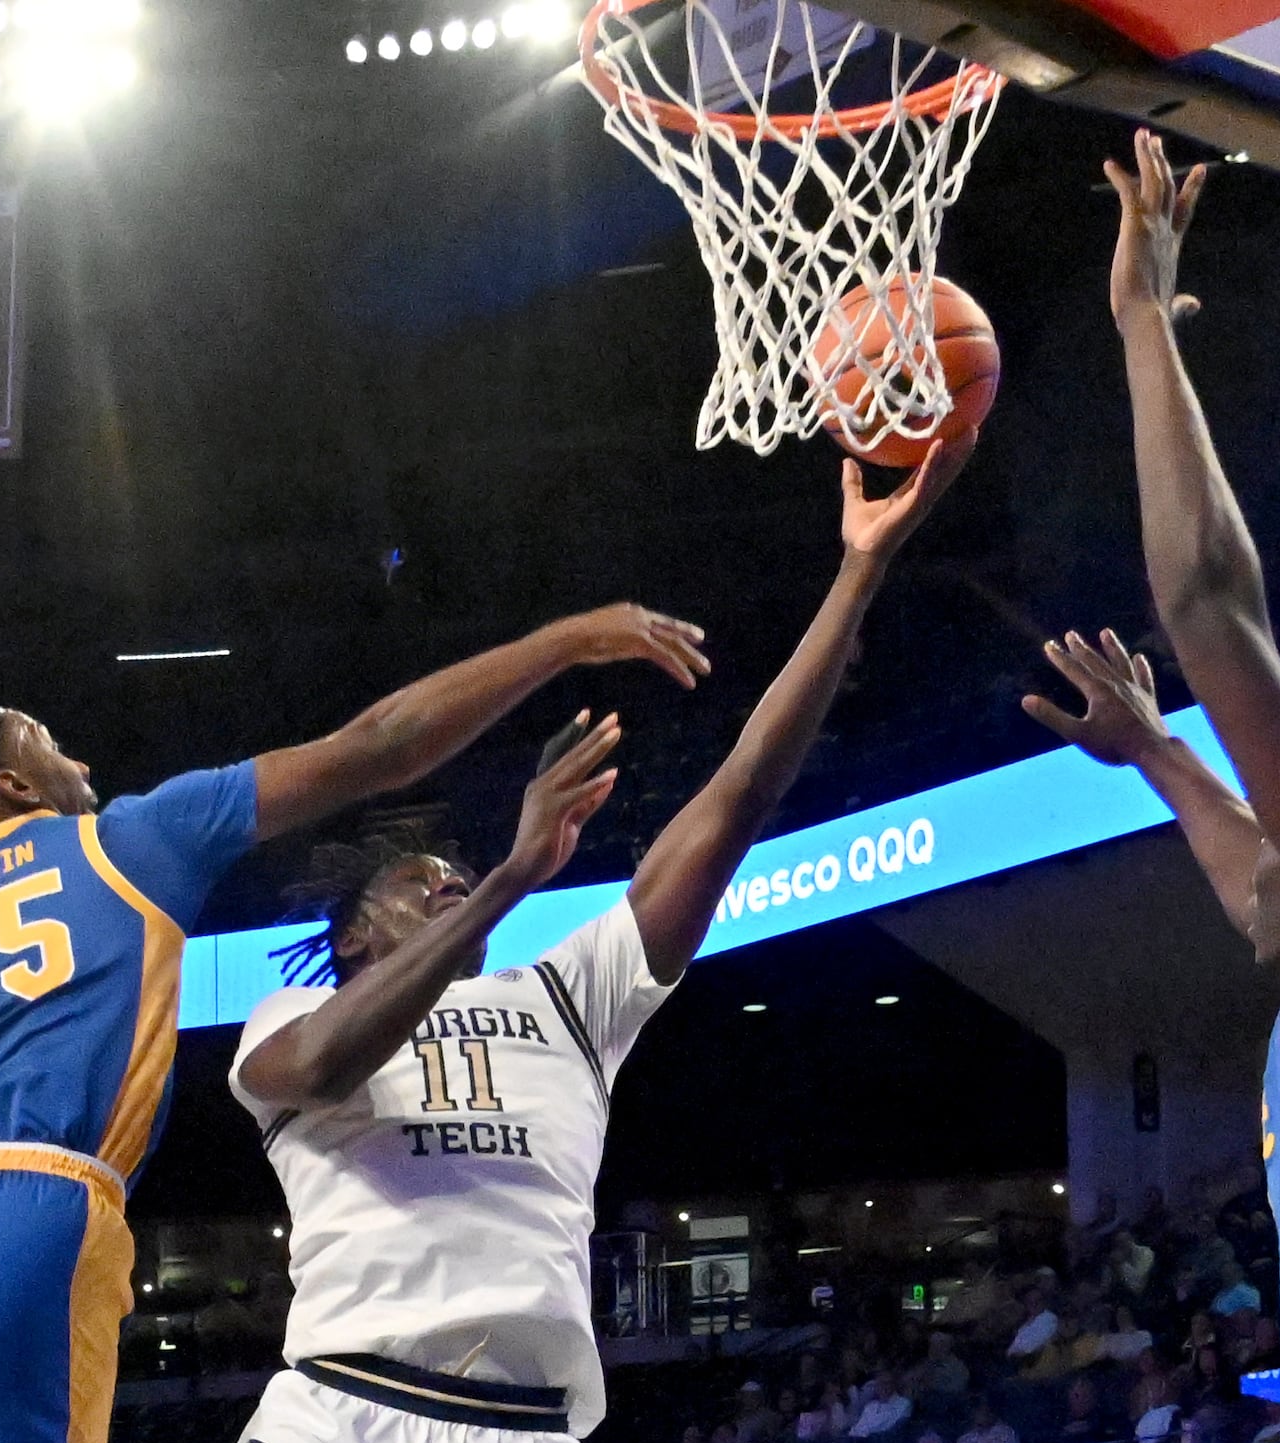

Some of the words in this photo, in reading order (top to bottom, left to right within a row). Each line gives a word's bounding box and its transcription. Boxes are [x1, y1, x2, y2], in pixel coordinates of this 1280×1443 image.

[715, 854, 841, 923] vesco
[848, 818, 934, 882] QQQ
[410, 1008, 549, 1046] ORGIA
[411, 1038, 504, 1113] 11
[402, 1122, 533, 1158] TECH
